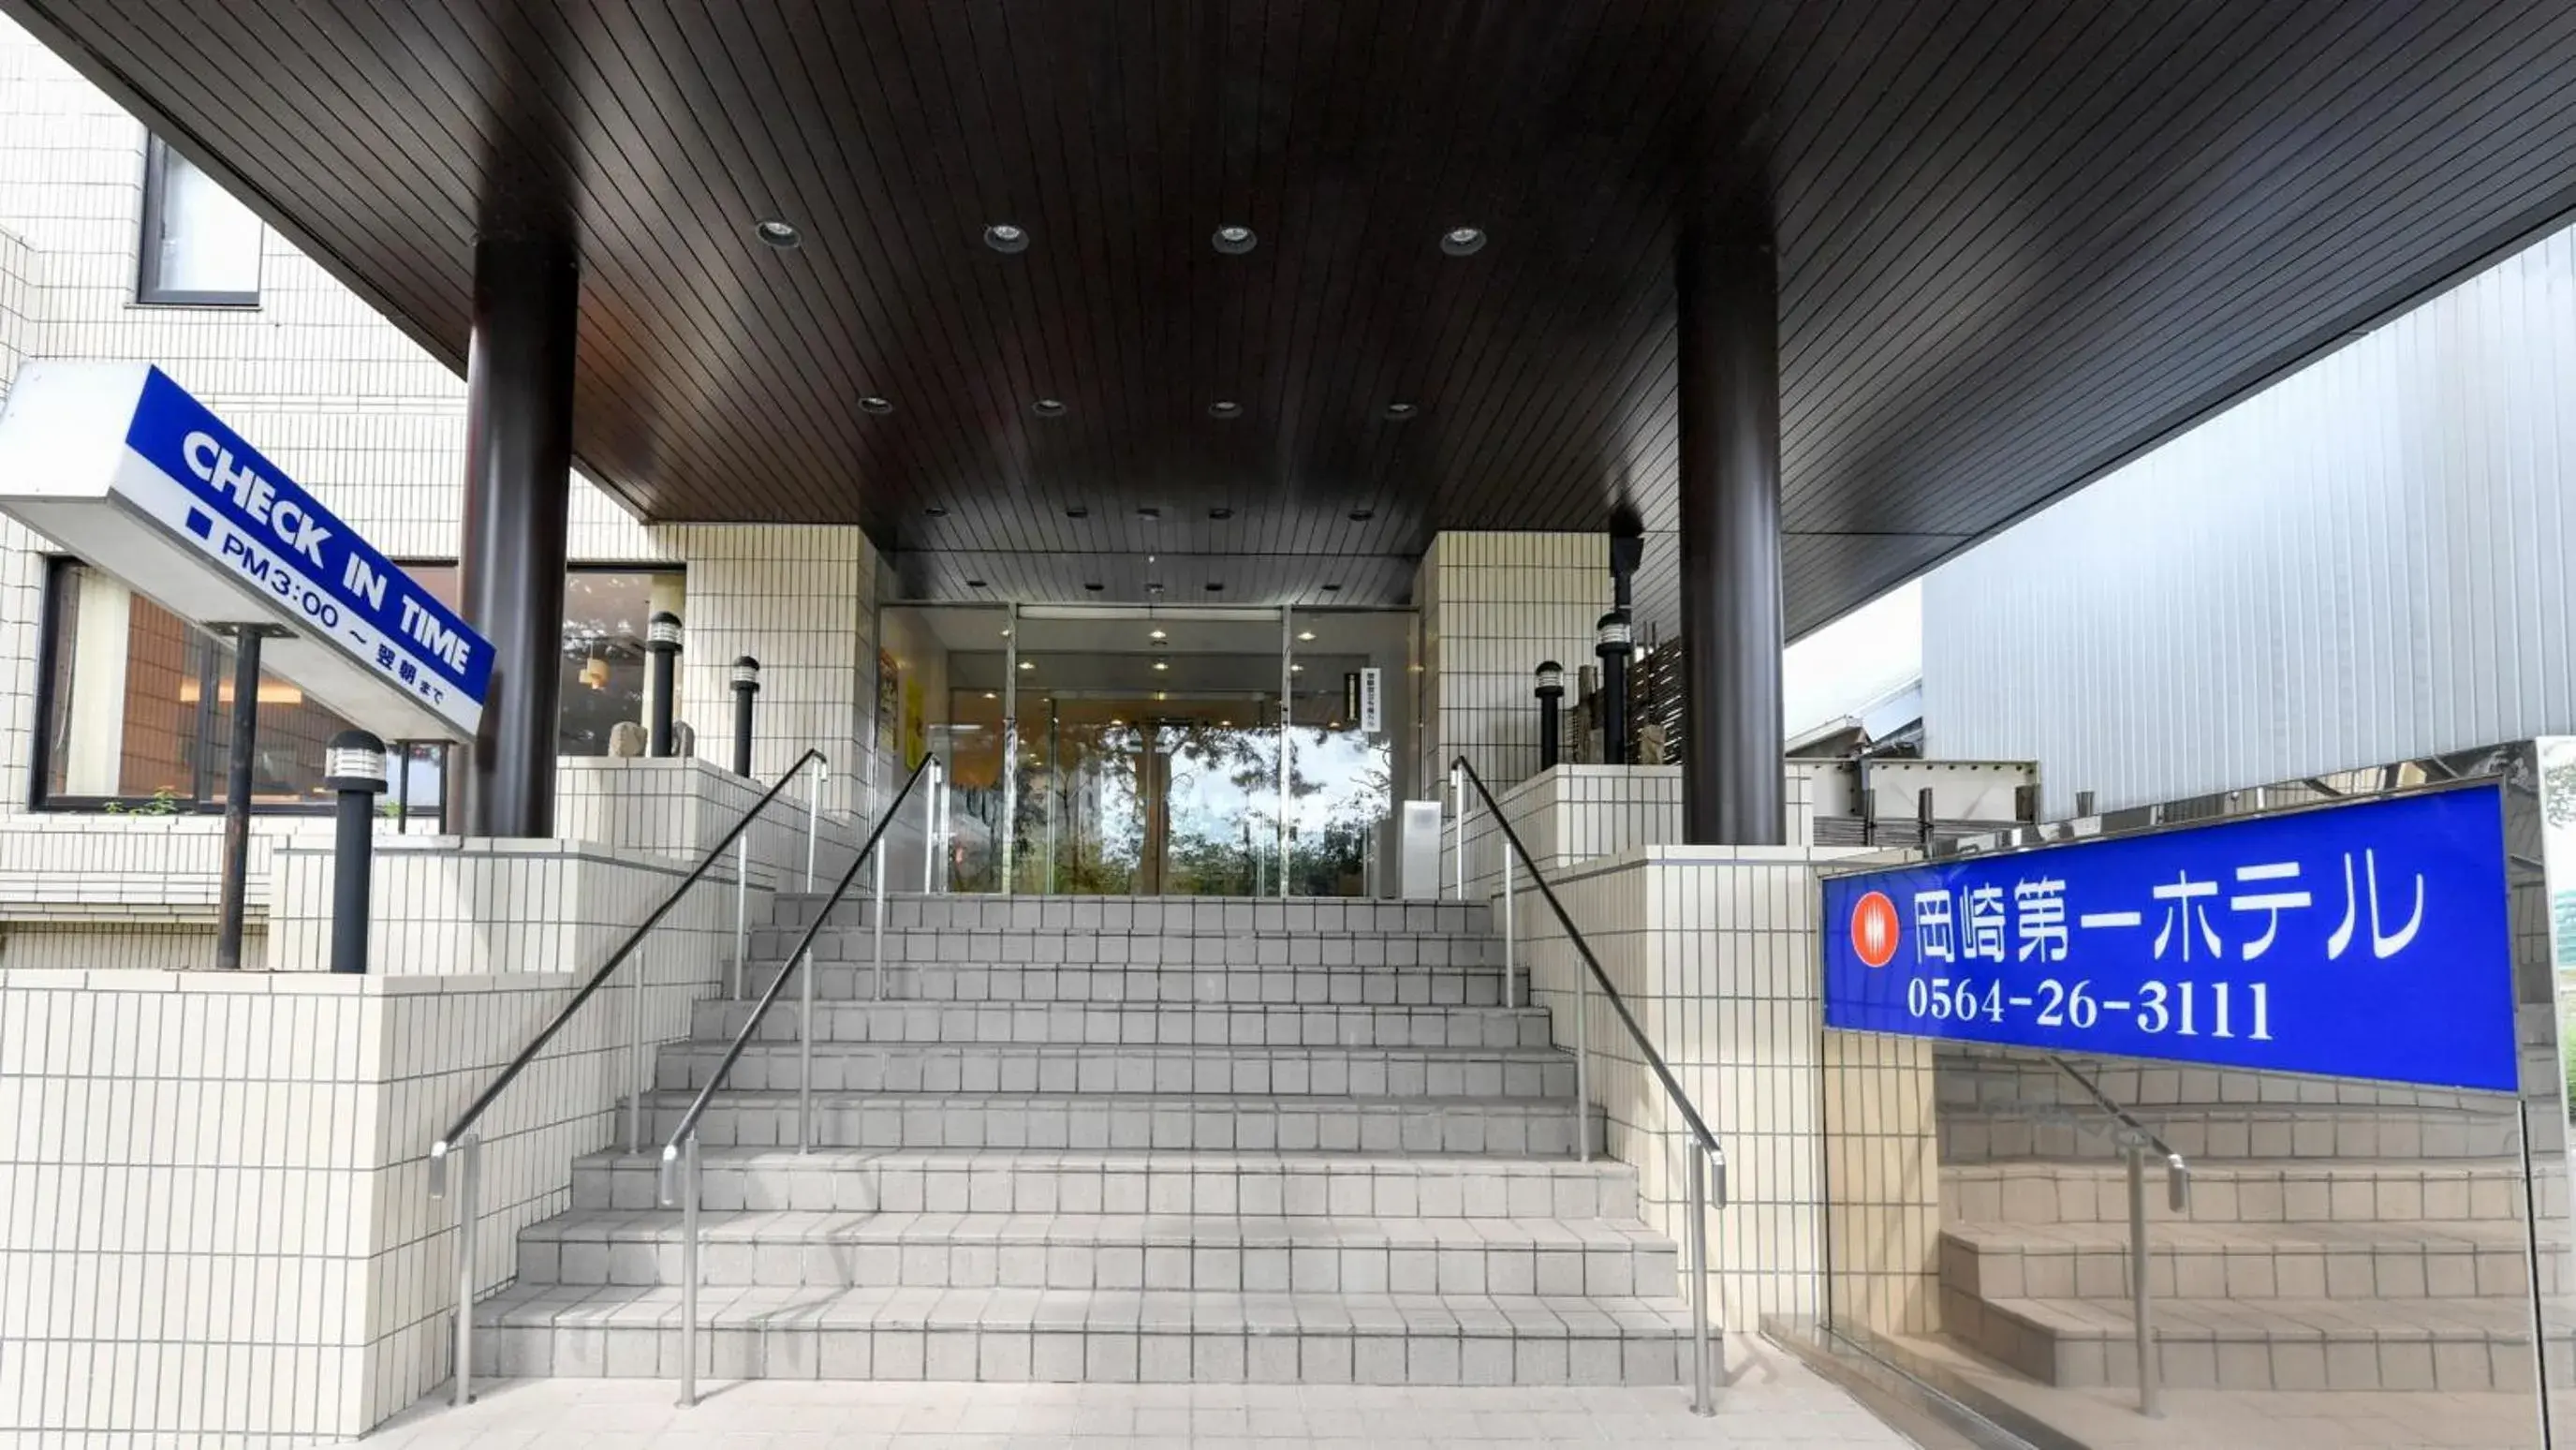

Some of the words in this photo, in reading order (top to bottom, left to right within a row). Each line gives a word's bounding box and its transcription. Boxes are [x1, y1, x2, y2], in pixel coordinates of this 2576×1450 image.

[183, 431, 332, 570] CHECK
[343, 551, 387, 612] IN
[401, 594, 471, 675] TIME
[1914, 847, 2423, 965] 岡崎第一ホテル
[1907, 977, 2273, 1042] 0564-26-3111
